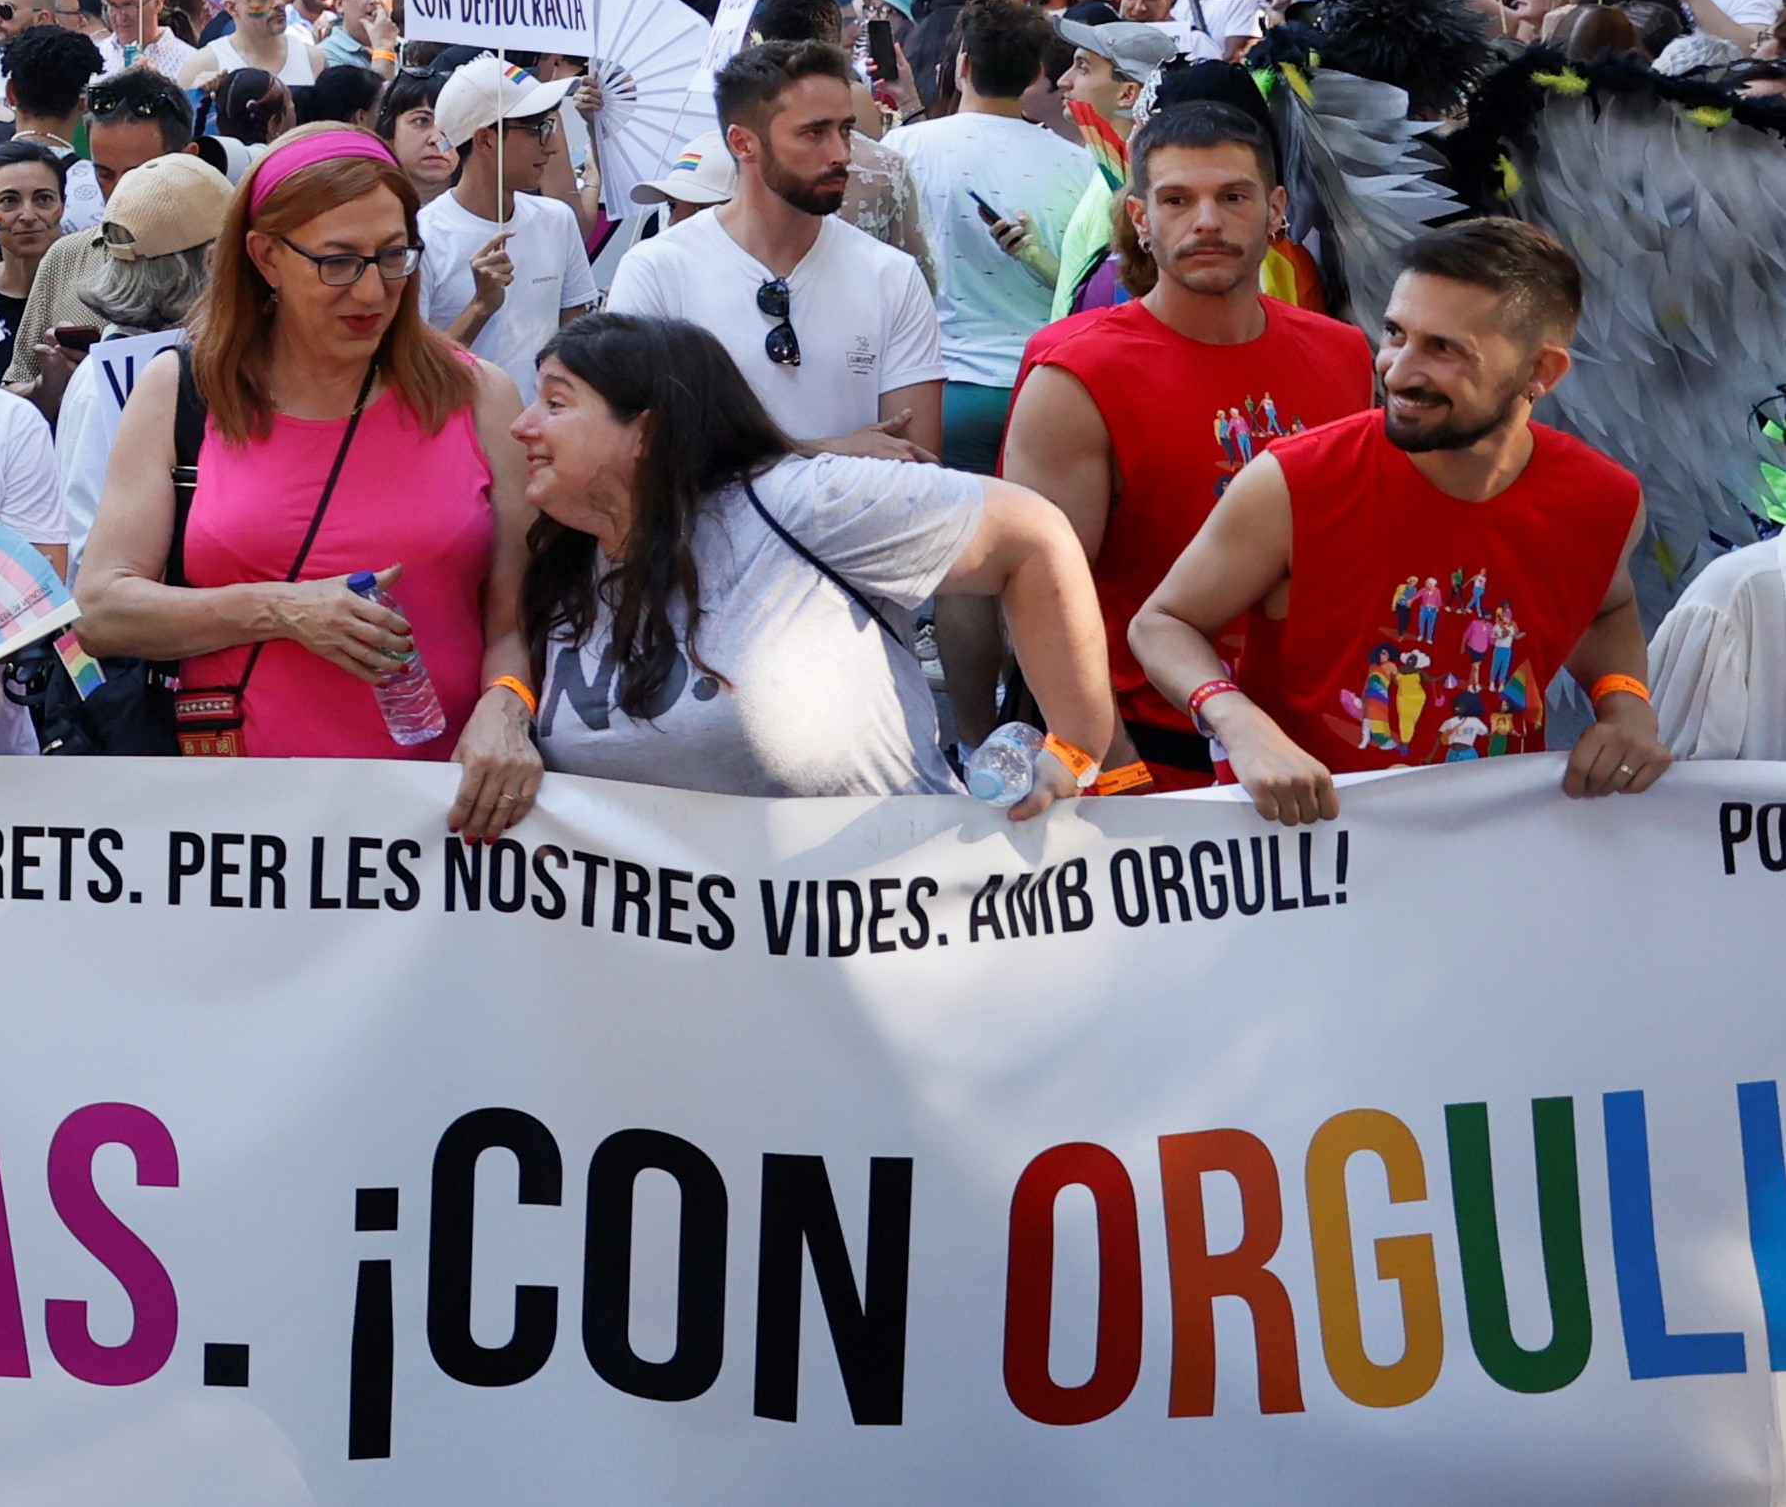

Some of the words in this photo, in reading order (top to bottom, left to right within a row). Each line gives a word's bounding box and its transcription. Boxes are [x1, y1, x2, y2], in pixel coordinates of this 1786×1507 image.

[169, 832, 286, 909] PER
[310, 837, 420, 911] LES
[445, 837, 735, 950] NOSTRES
[760, 877, 947, 957] VIDES.
[970, 858, 1093, 942] AMB
[1116, 831, 1348, 927] ORGULL!
[349, 1107, 913, 1460] ¡CON
